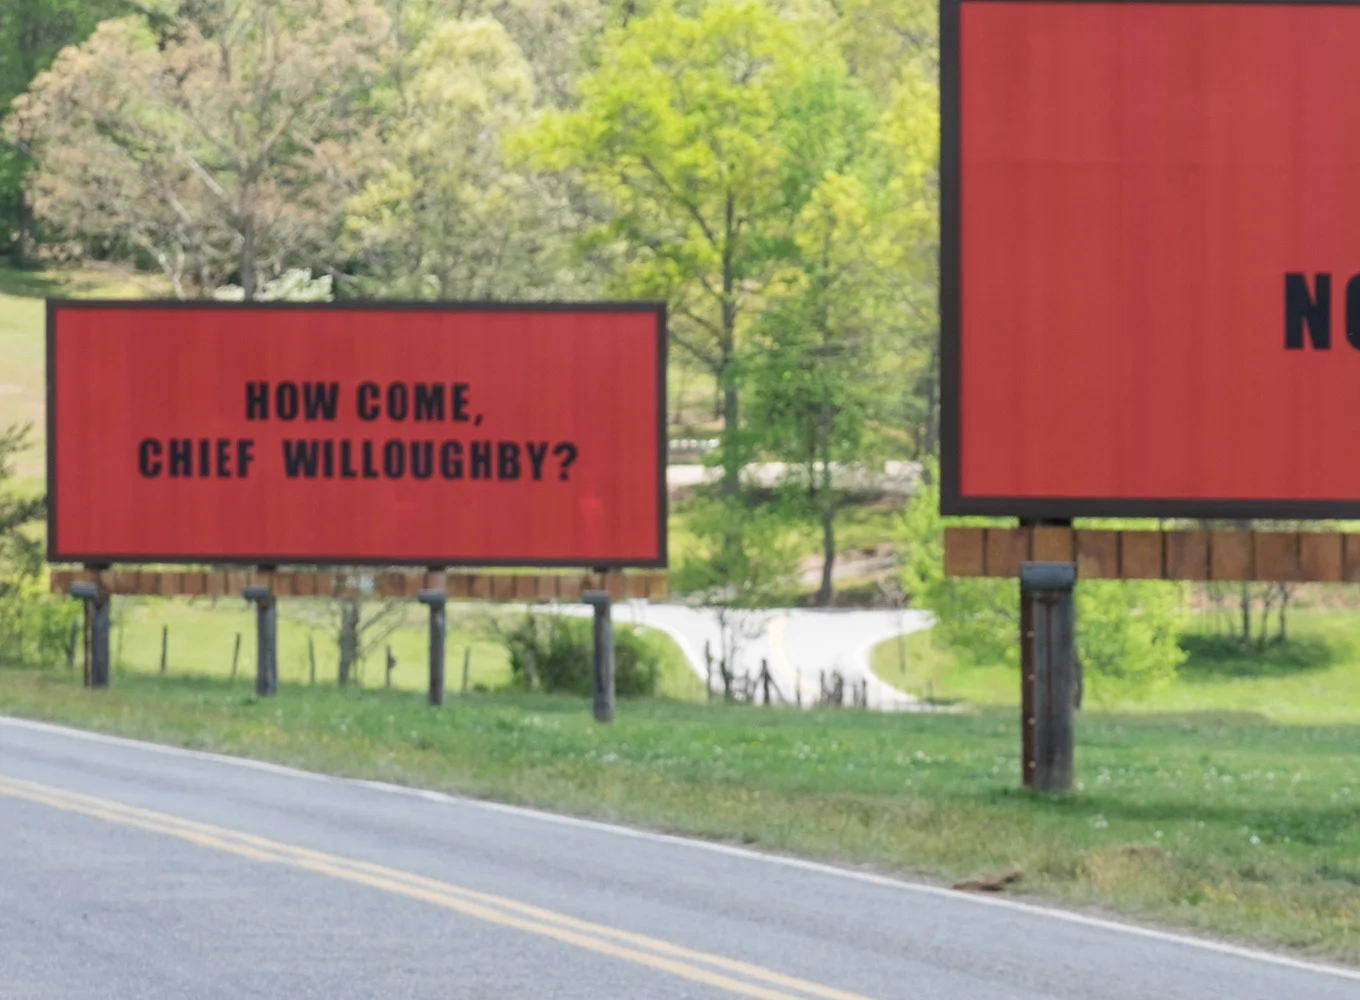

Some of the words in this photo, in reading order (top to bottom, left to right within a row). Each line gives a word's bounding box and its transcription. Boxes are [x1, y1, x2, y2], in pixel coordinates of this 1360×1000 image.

[245, 380, 340, 422] HOW
[355, 380, 483, 427] COME,
[137, 437, 255, 479] CHIEF
[281, 439, 579, 481] WILLOUGHBY?
